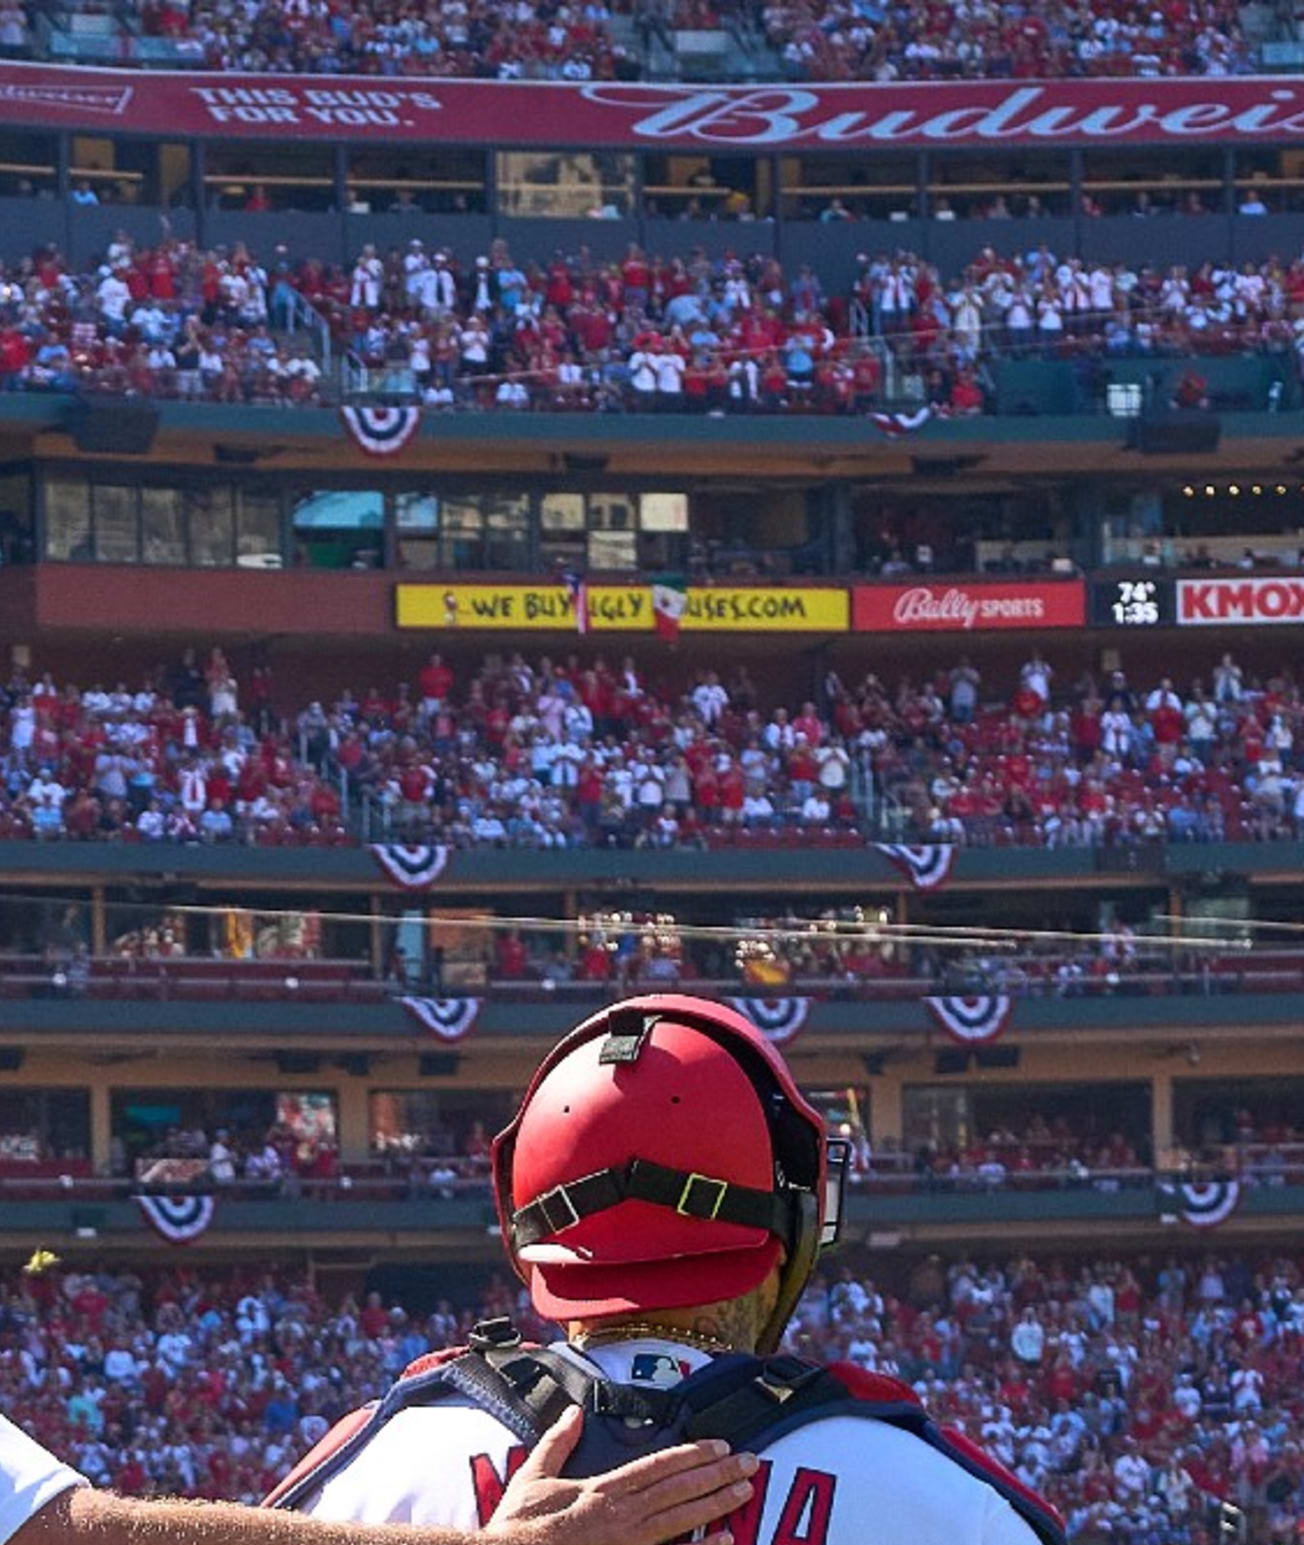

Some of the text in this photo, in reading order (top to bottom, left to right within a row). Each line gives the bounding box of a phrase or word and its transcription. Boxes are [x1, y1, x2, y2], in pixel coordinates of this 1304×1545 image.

[191, 87, 443, 110] THIS BUD'S
[207, 105, 415, 127] FOR YOU.
[1118, 581, 1156, 602] 74°
[471, 596, 512, 618] WE
[524, 592, 572, 620] BUY
[686, 593, 808, 620] USES.COM
[893, 587, 1045, 629] Bally SPORTS
[1112, 602, 1159, 624] 1:35
